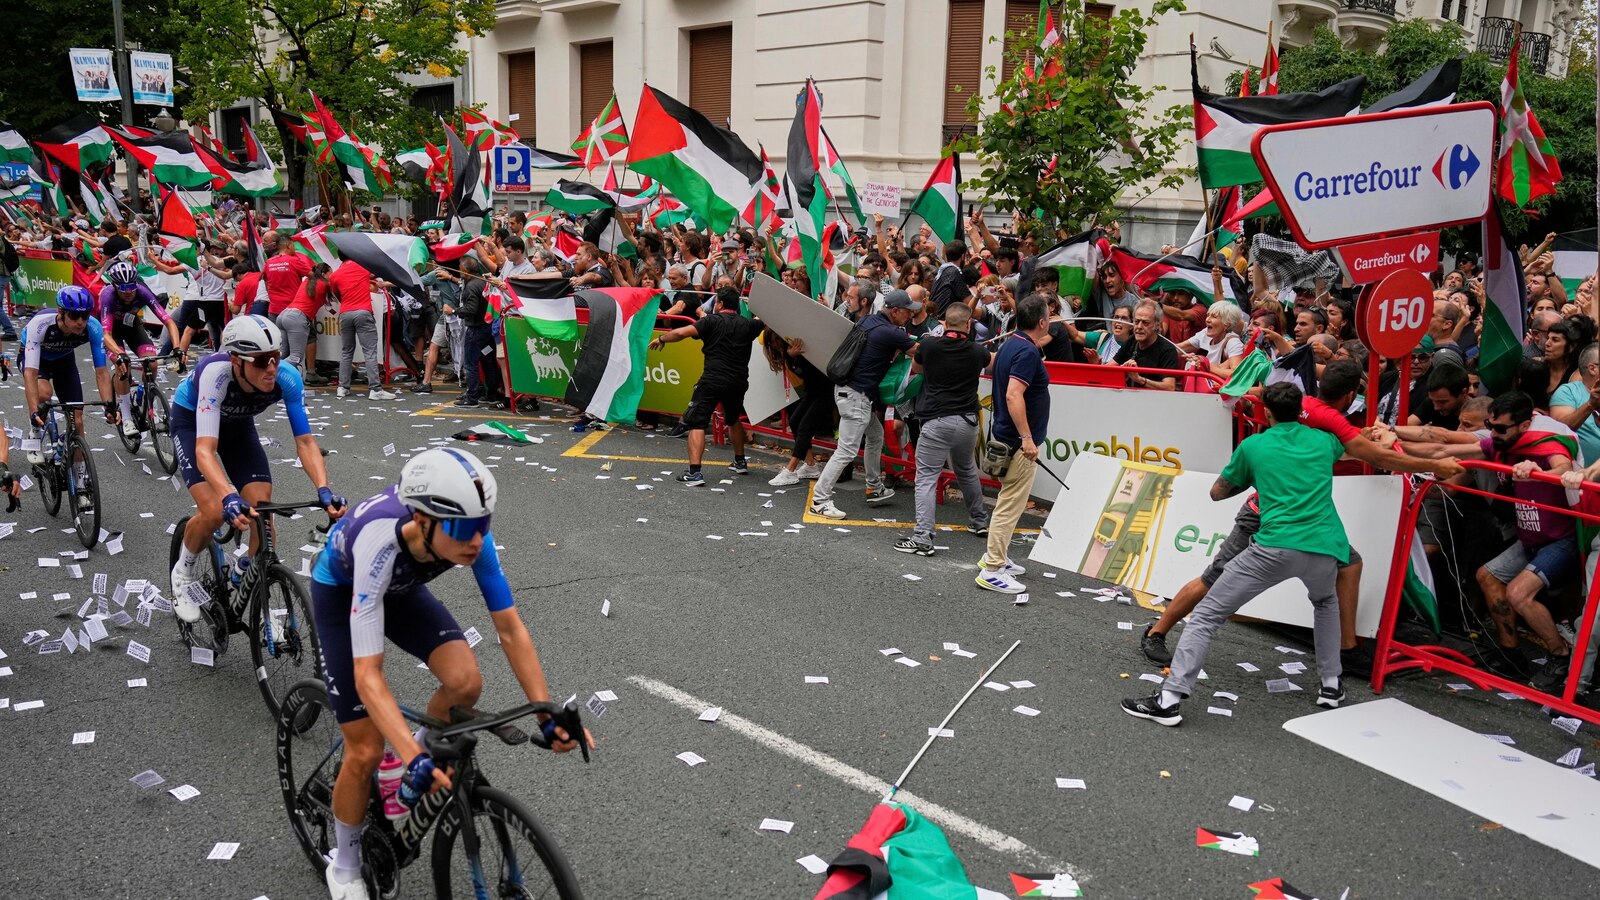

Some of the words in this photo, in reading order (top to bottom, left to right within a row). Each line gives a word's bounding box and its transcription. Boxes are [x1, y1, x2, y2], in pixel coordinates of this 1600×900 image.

[73, 56, 96, 65] MAMMA
[97, 56, 110, 66] MIA!
[134, 58, 155, 69] MAMMA
[156, 60, 170, 70] MIA!
[501, 148, 523, 184] P
[1293, 161, 1422, 202] Carrefour
[875, 198, 899, 207] GENOCIDE
[1353, 249, 1406, 271] Carrefour
[1378, 296, 1426, 332] 150
[277, 712, 290, 791] BLACK
